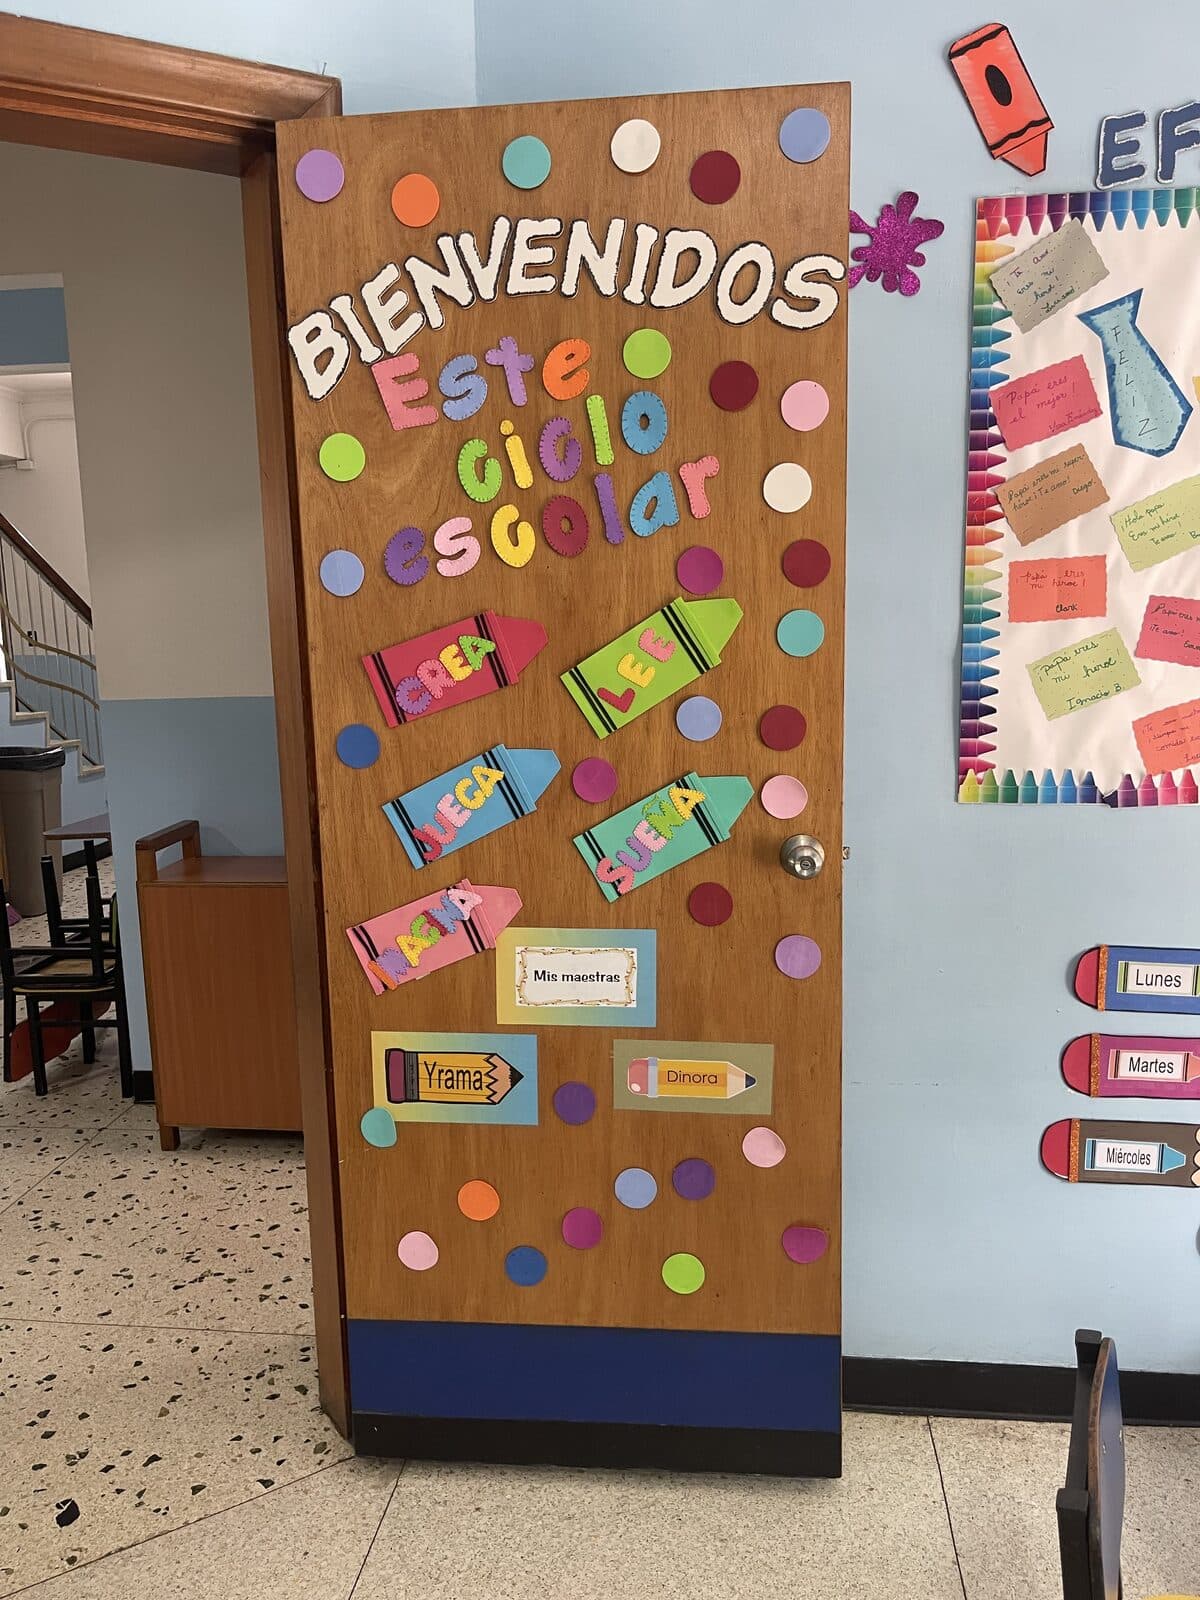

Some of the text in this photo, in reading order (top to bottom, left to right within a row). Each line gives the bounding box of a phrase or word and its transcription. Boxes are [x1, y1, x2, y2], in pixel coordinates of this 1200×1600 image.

[287, 214, 846, 401] BIENVENIDOS
[370, 335, 592, 431] Este
[1047, 376, 1067, 390] eres
[1111, 325, 1157, 437] FELIZ
[1009, 408, 1025, 424] el
[457, 390, 668, 503] ciclo
[384, 455, 720, 586] escolar
[1074, 641, 1098, 656] eres
[395, 634, 496, 715] CREA
[597, 627, 676, 714] LEE
[1052, 674, 1070, 683] mi
[1066, 690, 1110, 711] Ignacio
[412, 765, 504, 862] JUEGA
[367, 888, 483, 991] IMAGINA
[533, 969, 620, 983] Mis maestras
[1135, 968, 1182, 988] Lunes
[423, 1060, 483, 1090] Yrama
[667, 1070, 718, 1085] Dinora
[1128, 1056, 1174, 1074] Martes
[1106, 1147, 1151, 1166] Miércoles
